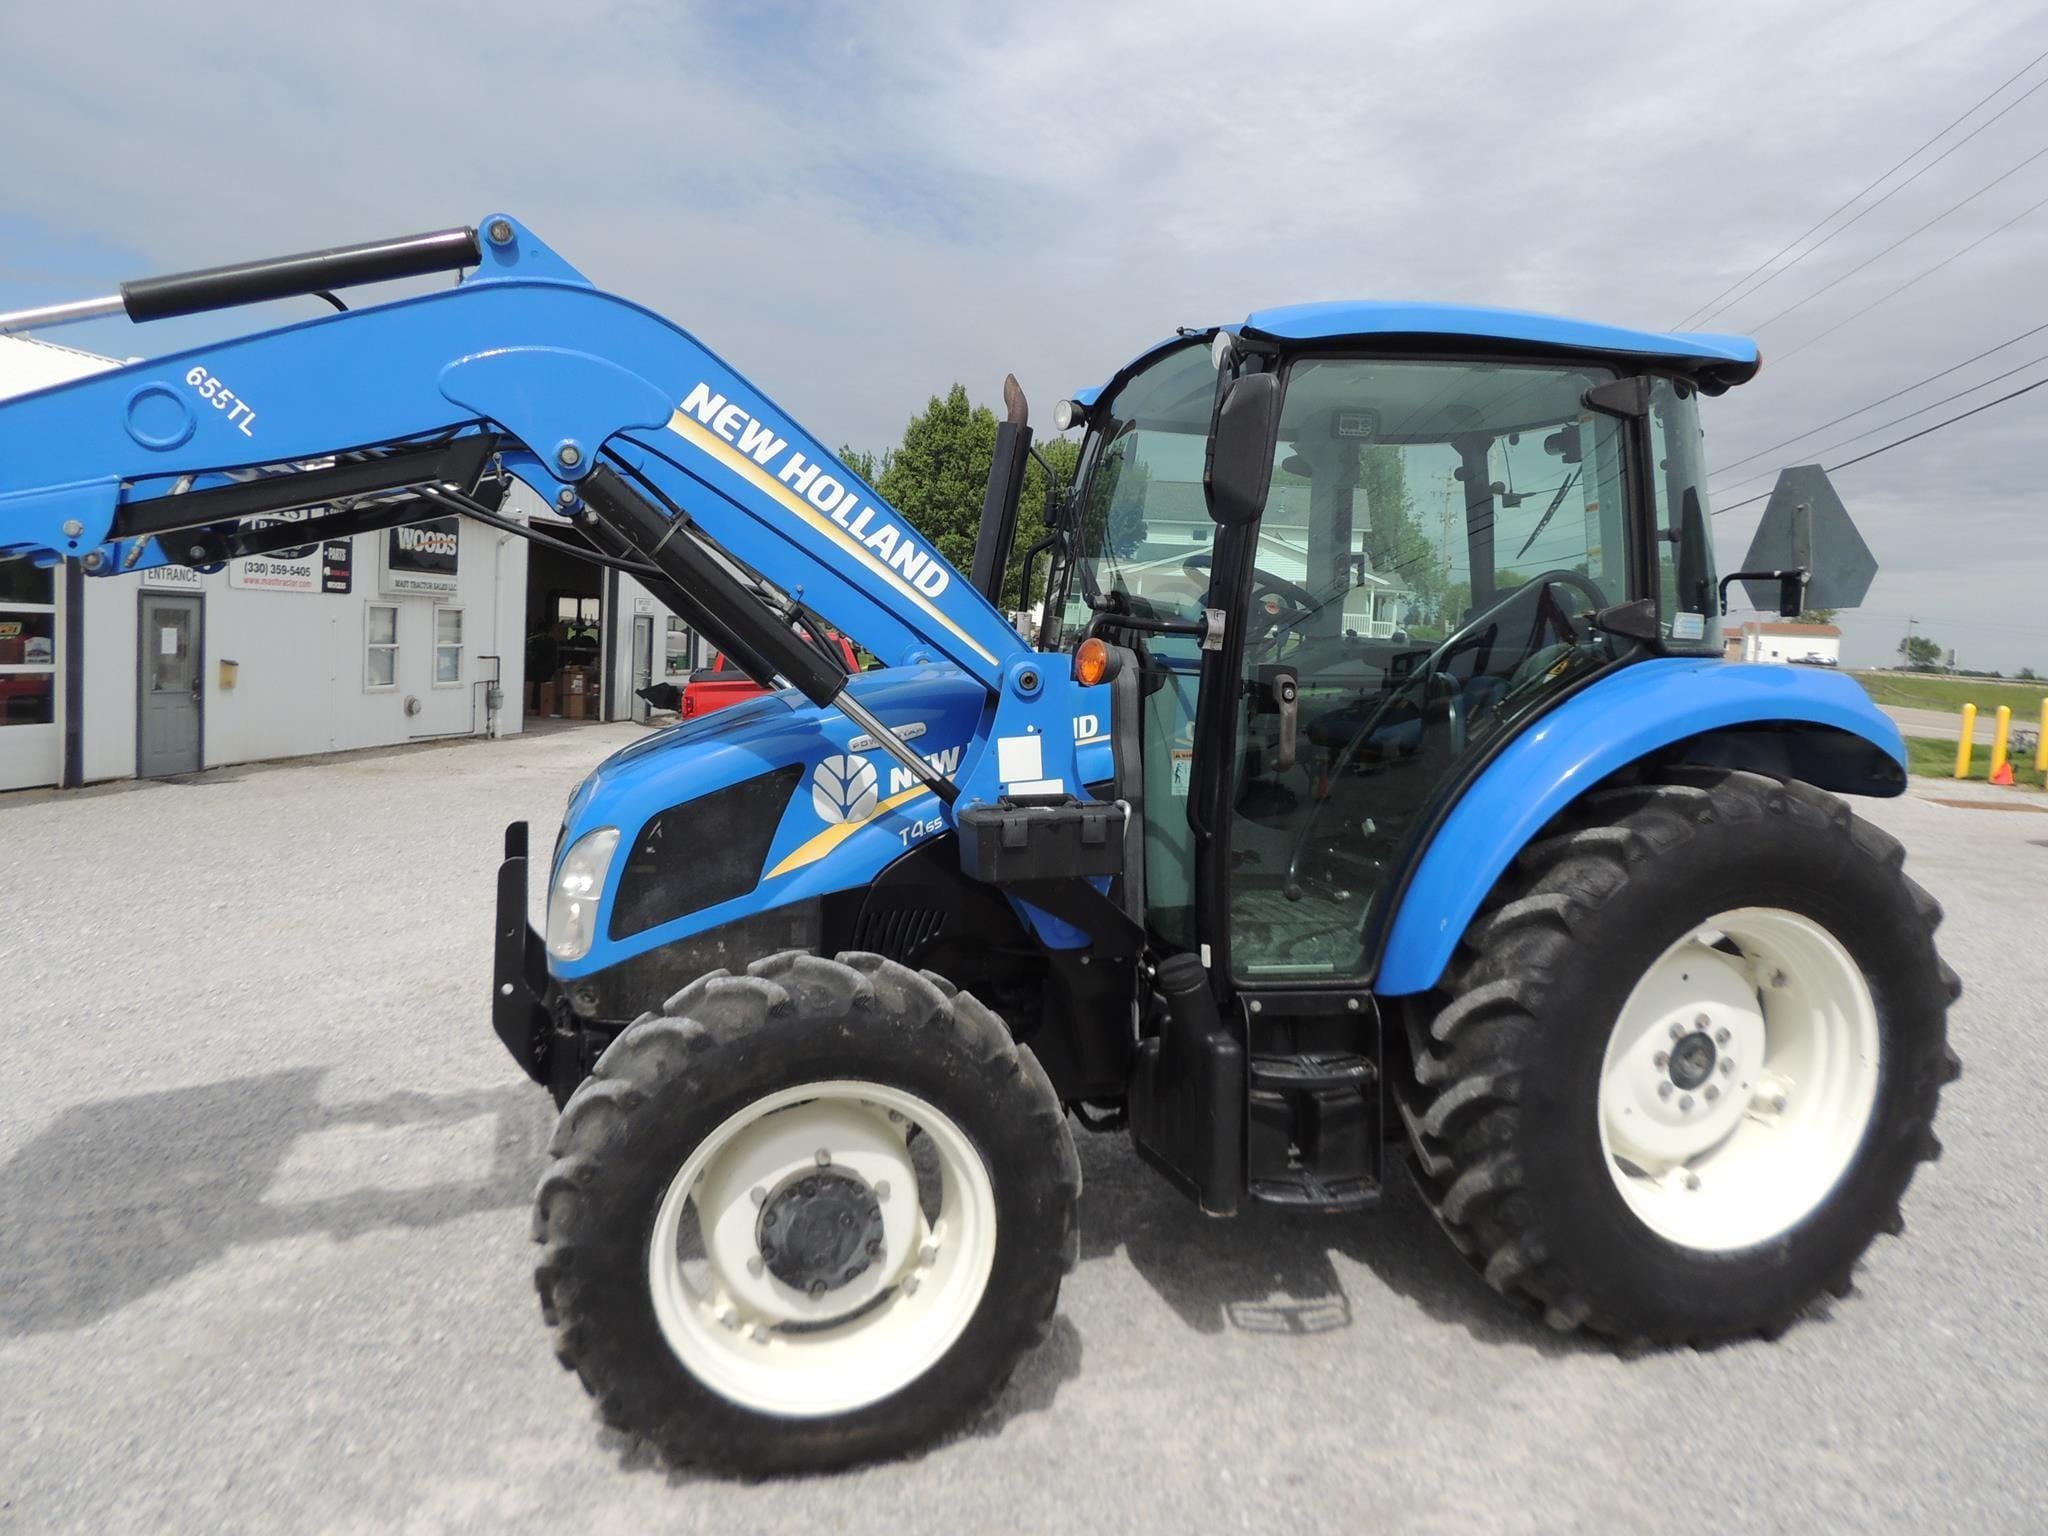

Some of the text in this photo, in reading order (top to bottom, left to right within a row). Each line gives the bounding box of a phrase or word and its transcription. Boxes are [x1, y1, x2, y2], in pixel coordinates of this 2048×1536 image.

[186, 366, 256, 437] 655TL
[680, 382, 949, 598] NEW HOLLAND
[328, 547, 346, 562] PARTS
[398, 527, 457, 556] WOODS
[148, 567, 198, 582] ENTRANCE
[244, 561, 312, 577] (330) 359-5405
[410, 581, 432, 590] TRACTOR
[890, 745, 960, 794] NW
[899, 817, 943, 846] T4.65
